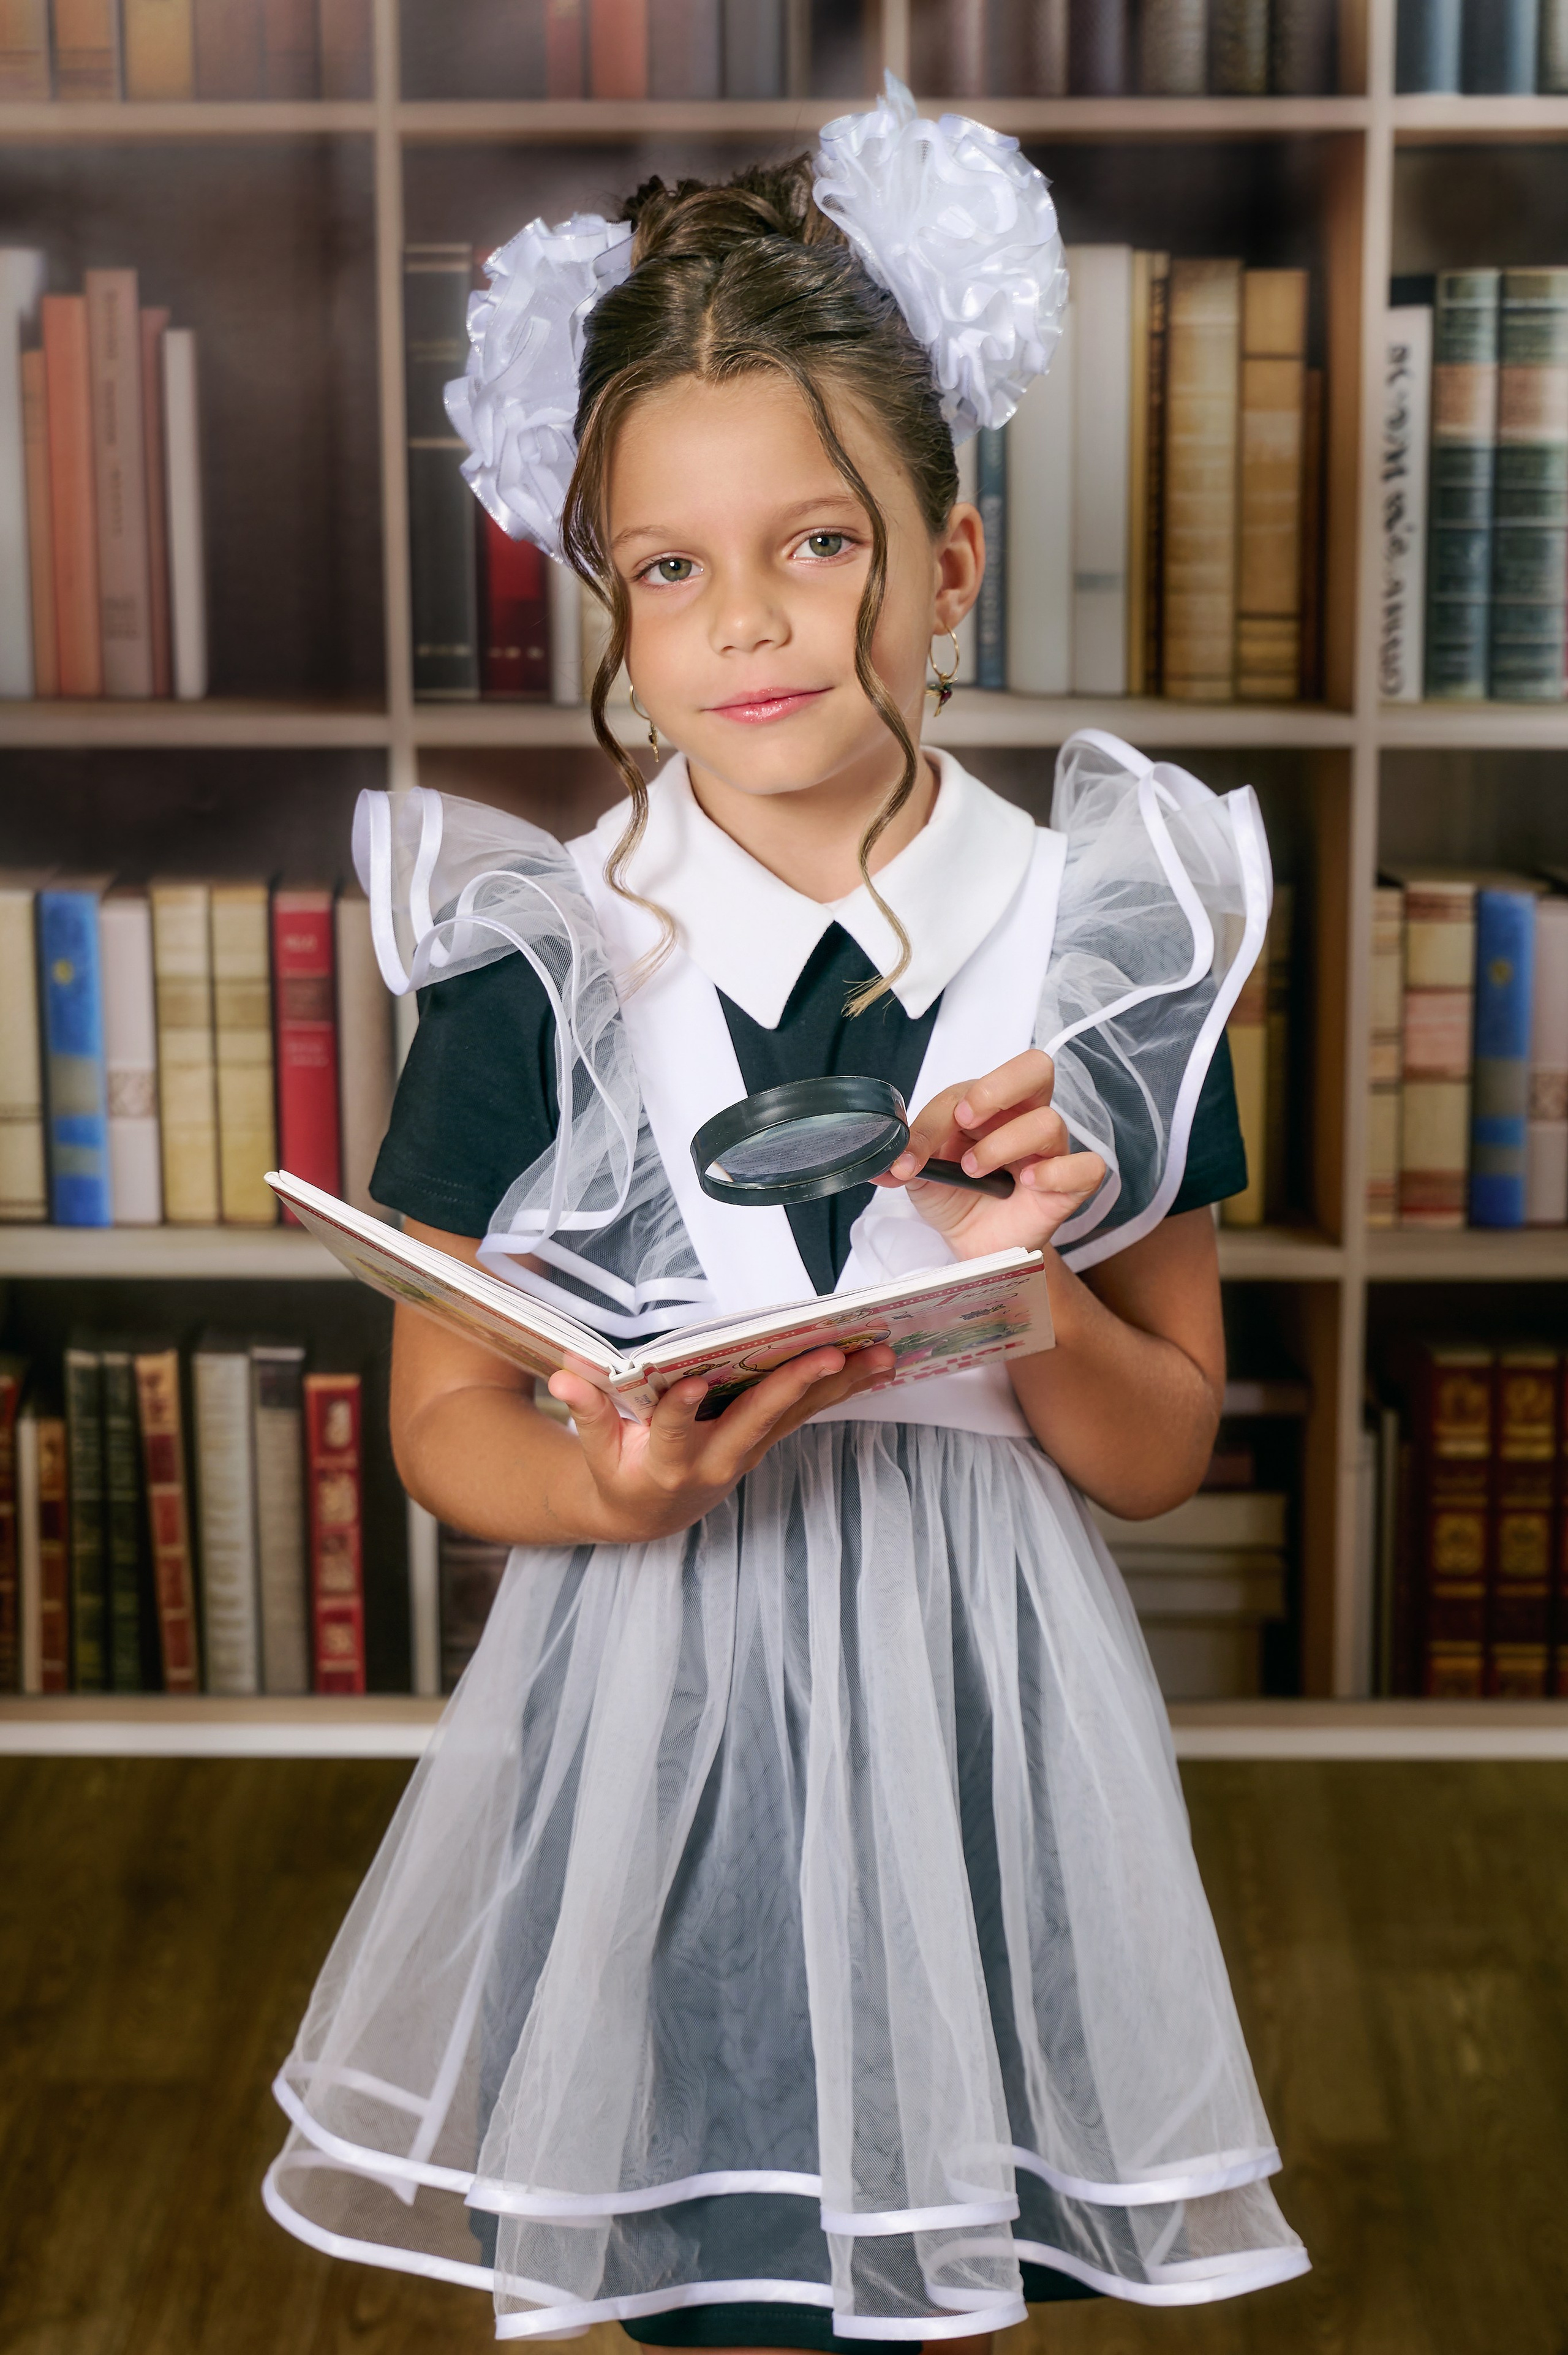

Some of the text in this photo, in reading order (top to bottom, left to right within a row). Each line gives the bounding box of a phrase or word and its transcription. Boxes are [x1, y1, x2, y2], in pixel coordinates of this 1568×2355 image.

[677, 1271, 1027, 1367] ШКОЛЬНАЯ БИБЛИОТЕКА
[871, 1357, 984, 1392] НИЕ
[896, 1340, 1025, 1377] ССНОЕ
